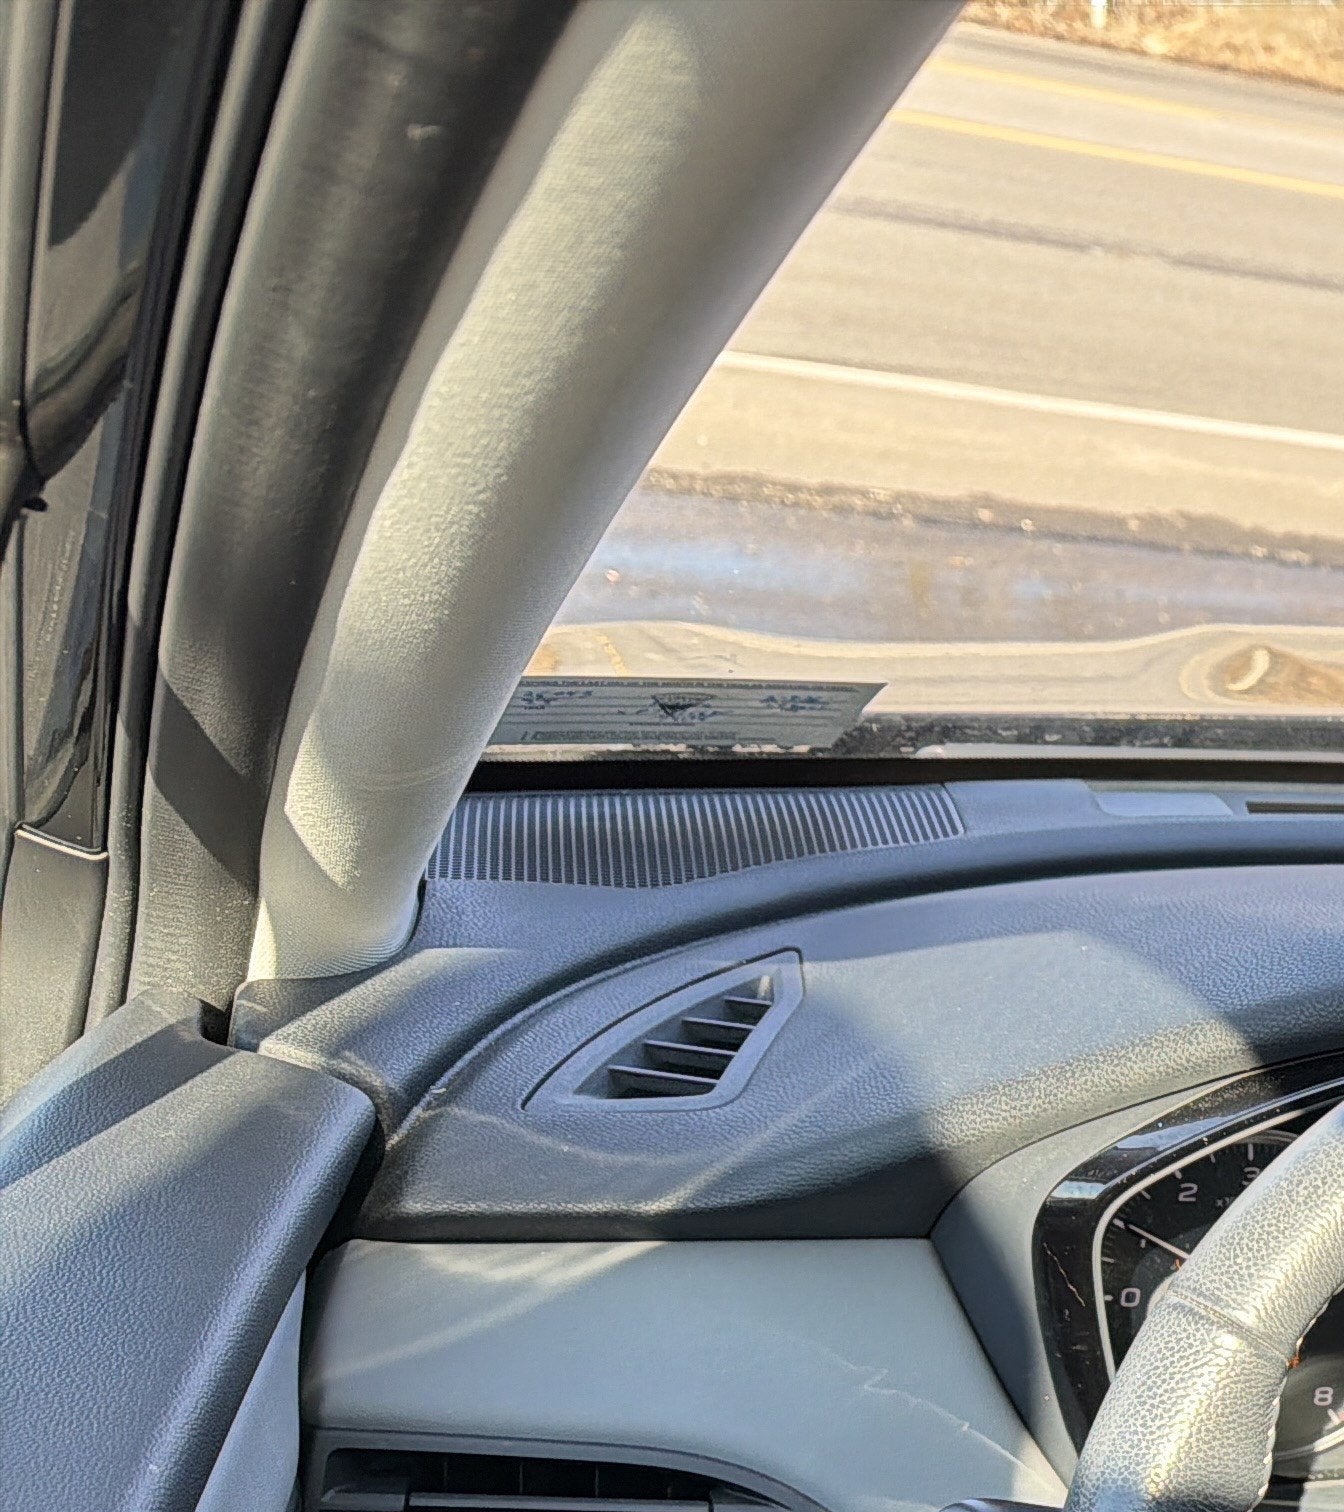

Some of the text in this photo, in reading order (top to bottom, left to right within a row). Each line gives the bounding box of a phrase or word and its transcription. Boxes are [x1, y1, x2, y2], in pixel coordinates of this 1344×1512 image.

[1178, 1183, 1198, 1202] 2
[1120, 1287, 1141, 1308] 0
[1314, 1386, 1334, 1406] 8
